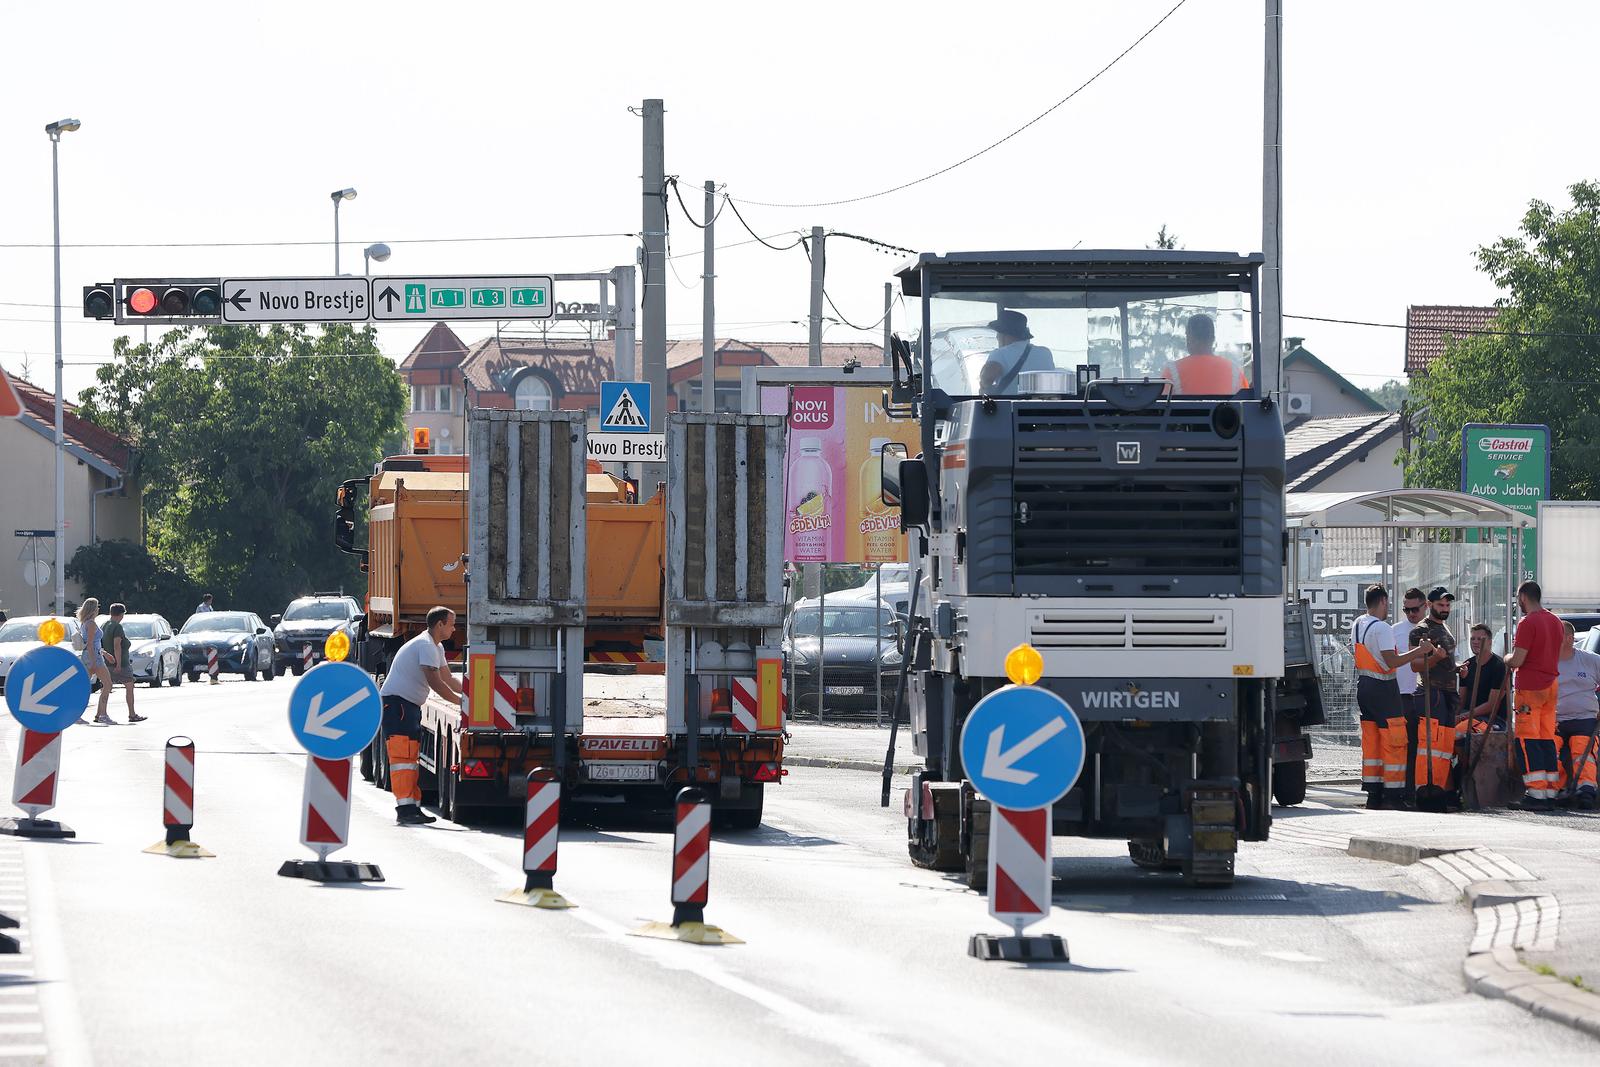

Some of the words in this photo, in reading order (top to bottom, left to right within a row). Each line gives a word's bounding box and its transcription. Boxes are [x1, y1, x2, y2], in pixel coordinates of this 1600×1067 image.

[260, 291, 299, 310] Novo
[304, 290, 365, 314] Brestje
[795, 401, 827, 411] NOVI
[793, 412, 829, 423] OKUS
[587, 439, 617, 455] Novo
[1492, 439, 1529, 451] Castrol
[1471, 483, 1497, 496] Auto
[1502, 483, 1540, 496] Jablan
[790, 515, 831, 533] CEDEVITA
[1081, 690, 1180, 709] WIRTGEN
[587, 739, 657, 750] PAVELLI
[595, 766, 608, 778] ZG
